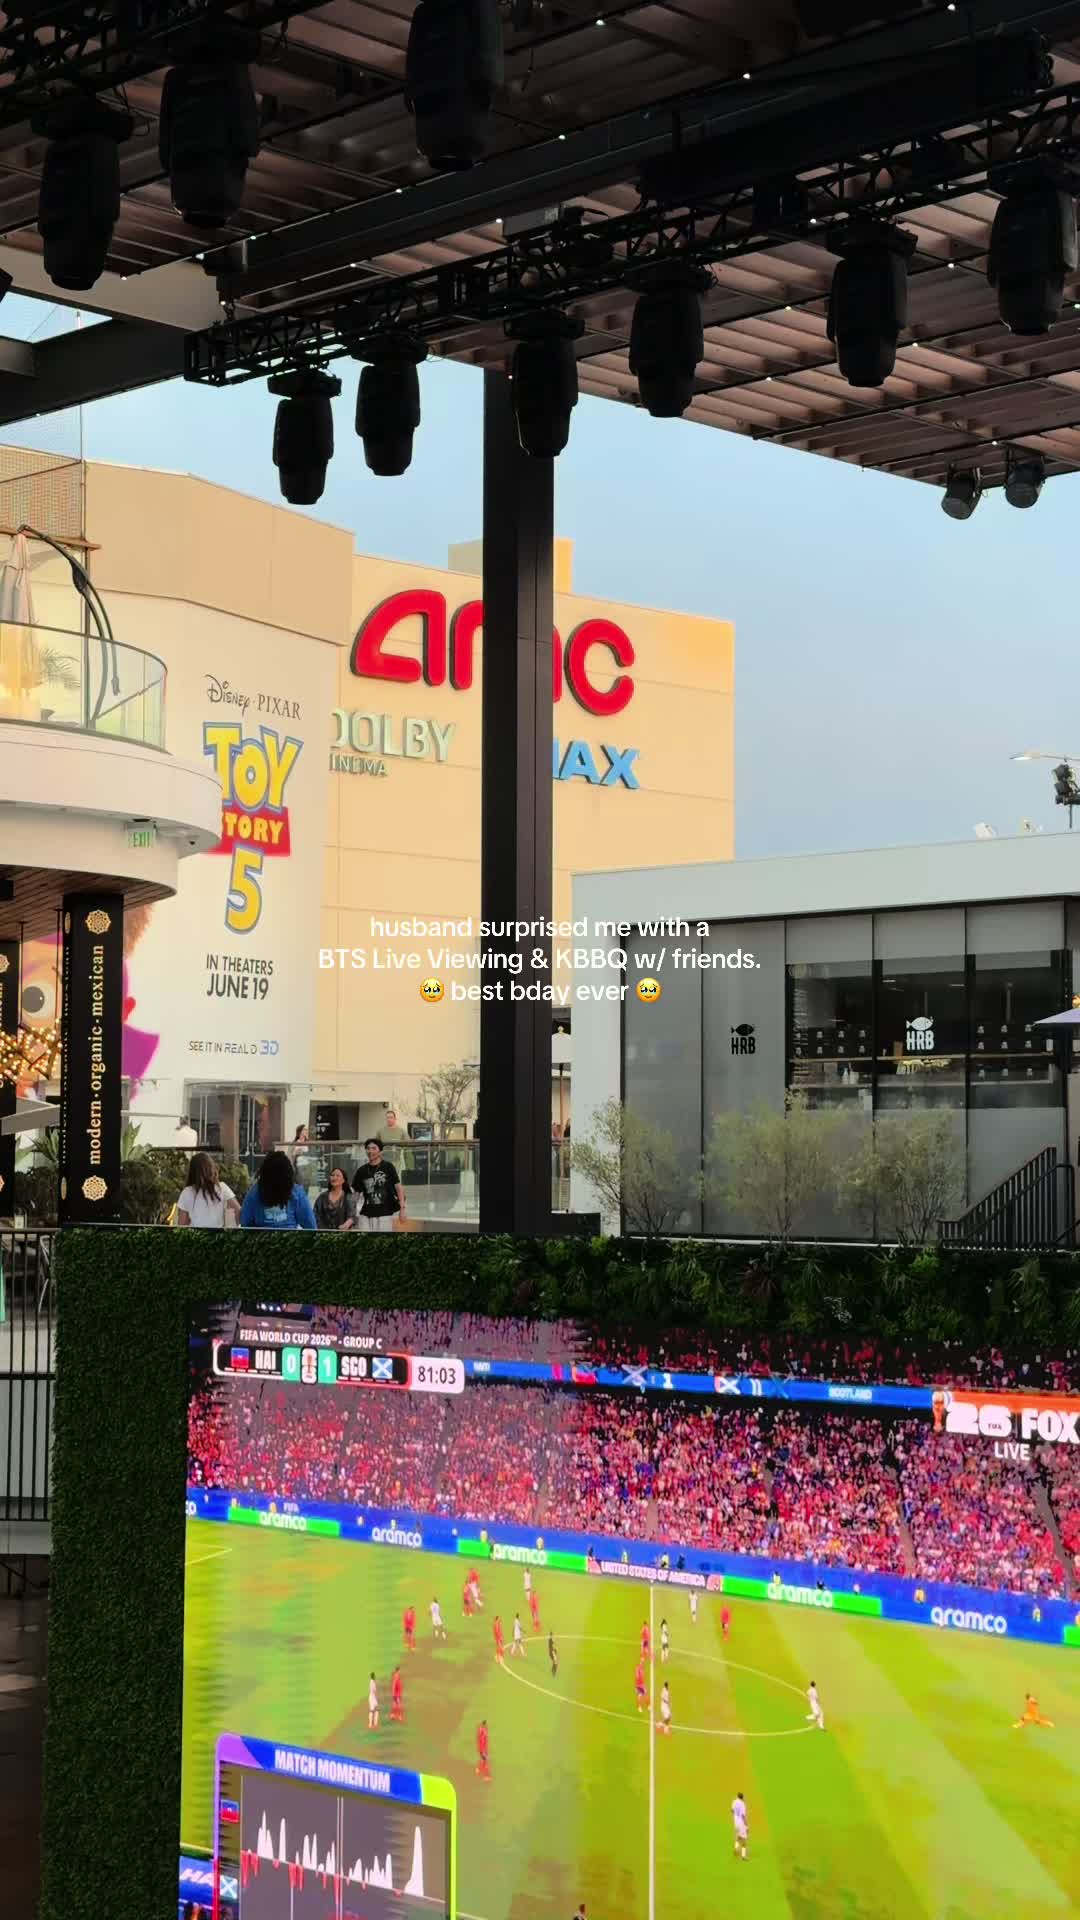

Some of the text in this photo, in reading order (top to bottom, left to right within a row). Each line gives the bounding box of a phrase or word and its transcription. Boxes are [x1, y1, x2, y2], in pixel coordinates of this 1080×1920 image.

[258, 692, 301, 720] PIXAR
[329, 752, 388, 777] INEMA
[552, 736, 640, 789] AX
[222, 812, 285, 845] TORY
[225, 843, 264, 935] 5
[206, 954, 274, 976] IN THEATERS
[207, 973, 270, 1000] JUNE 19
[189, 1041, 204, 1052] SEE
[205, 1042, 213, 1052] IT
[214, 1042, 222, 1053] IN
[260, 1040, 279, 1056] 3D
[731, 1037, 756, 1055] HRB
[906, 1030, 935, 1051] HRB
[86, 945, 106, 1165] modern organic mexican
[240, 1328, 259, 1341] FIFA
[260, 1331, 291, 1344] WORLD
[292, 1333, 310, 1345] CUP
[343, 1336, 375, 1349] GROUP
[376, 1338, 383, 1349] C
[255, 1349, 276, 1370] HAI
[286, 1353, 297, 1374] 0
[323, 1357, 332, 1377] 1
[341, 1355, 368, 1377] SCO
[418, 1365, 456, 1384] 81:03
[1021, 1408, 1080, 1444] FOX
[994, 1441, 1031, 1461] LIVE
[259, 1511, 307, 1531] aramco
[372, 1526, 422, 1548] aramco
[493, 1542, 547, 1565] aramco
[601, 1560, 706, 1587] UNITED STATES OF AMERICA
[767, 1582, 834, 1608] aramco
[931, 1606, 1007, 1634] aramco
[275, 1749, 390, 1793] MATCH MOMENTUM
